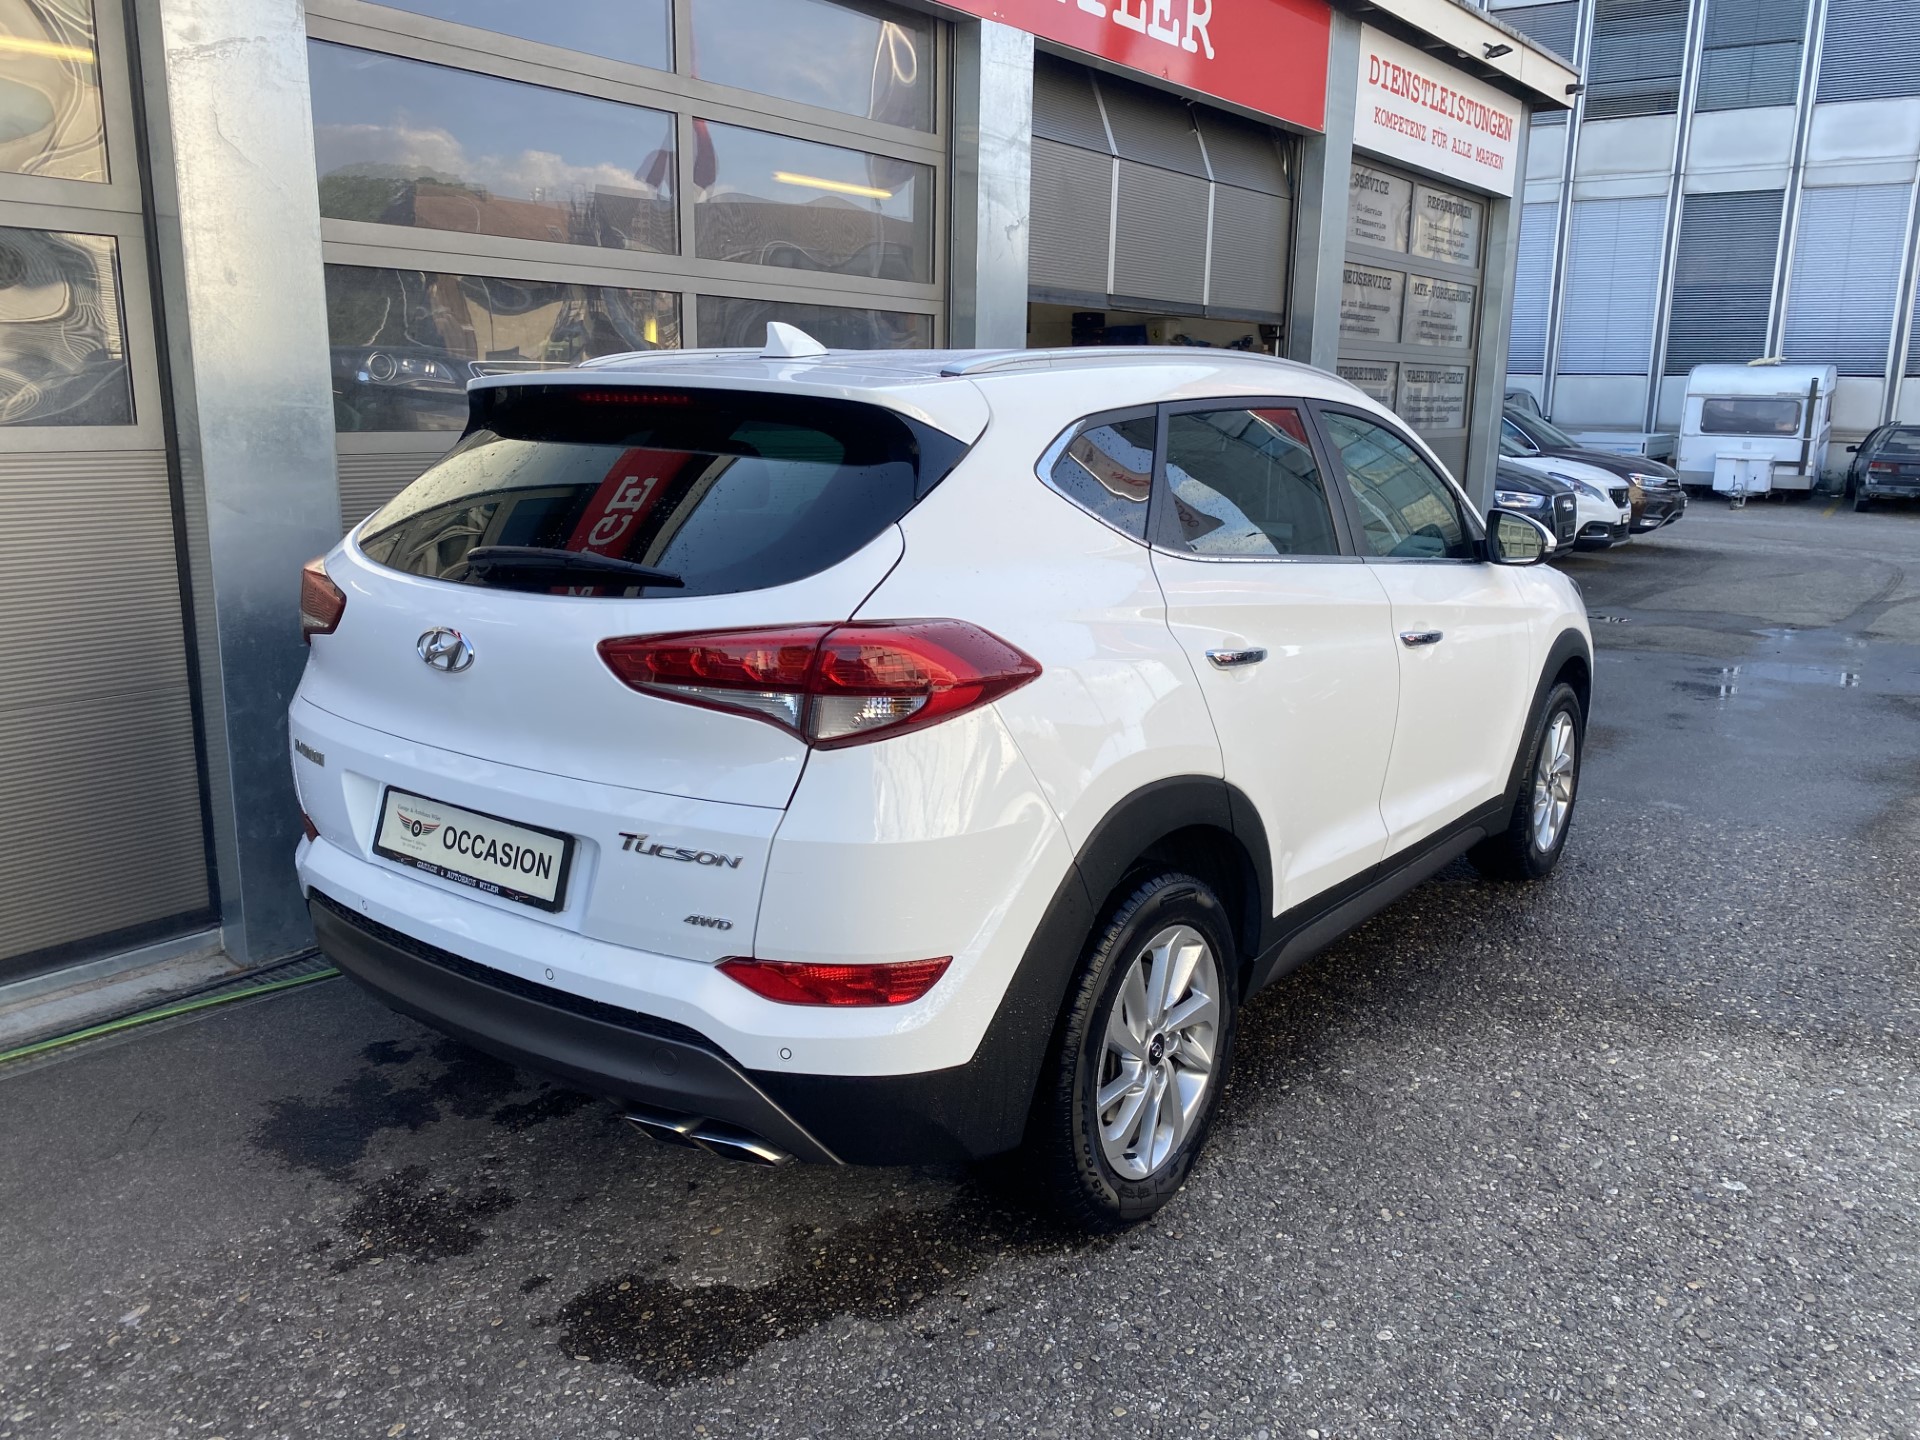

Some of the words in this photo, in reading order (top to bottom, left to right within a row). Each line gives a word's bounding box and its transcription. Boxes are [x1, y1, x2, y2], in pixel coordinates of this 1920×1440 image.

[1369, 54, 1513, 142] DIENSTLEISTUNGEN
[1374, 106, 1427, 142] KOMPETENZ
[1431, 127, 1448, 150] FÜR
[1451, 137, 1473, 159] ALLE
[1475, 146, 1505, 171] MARKEN
[1353, 173, 1390, 196] SERVICE
[1342, 269, 1392, 291] NEUSERVICE
[1336, 365, 1388, 382] FBEREITUNG
[443, 826, 553, 880] OCCASION
[618, 831, 744, 869] TUCSON
[479, 880, 499, 894] WILER
[683, 913, 734, 931] 4WD
